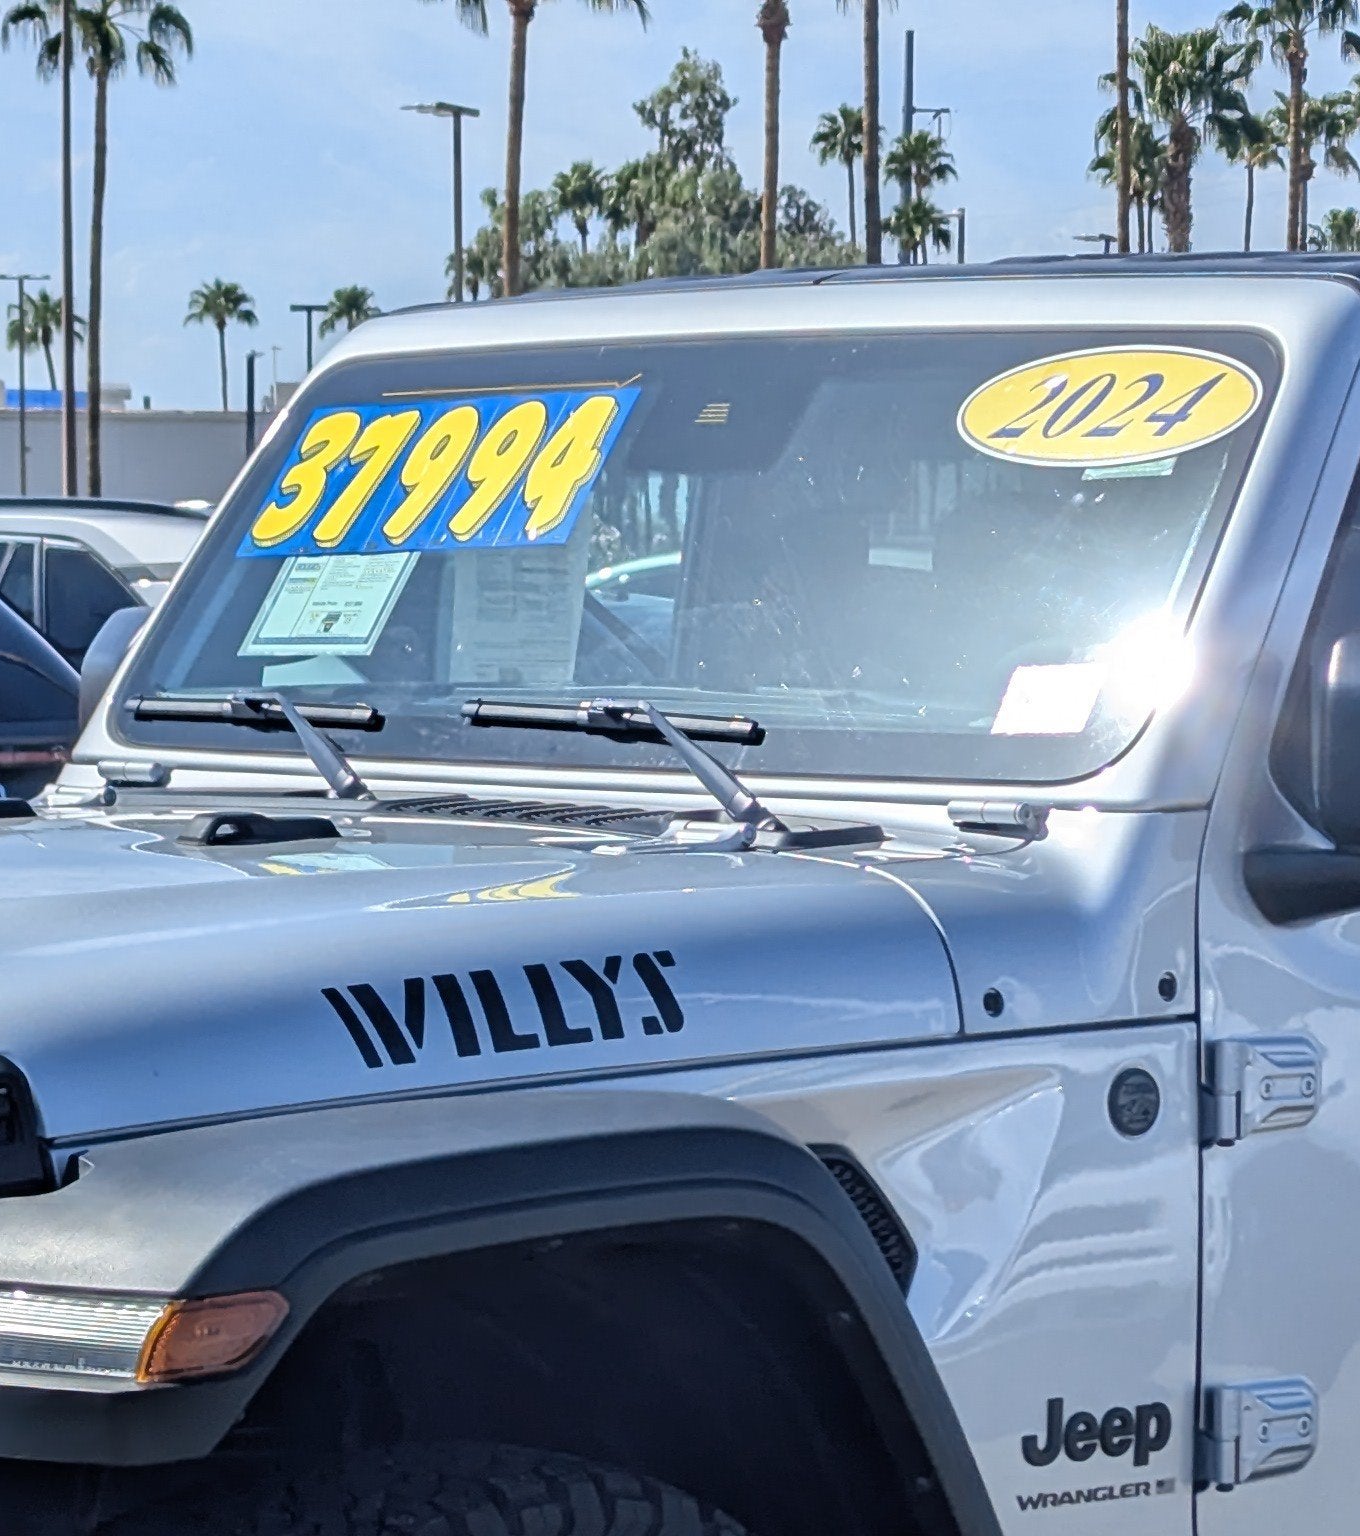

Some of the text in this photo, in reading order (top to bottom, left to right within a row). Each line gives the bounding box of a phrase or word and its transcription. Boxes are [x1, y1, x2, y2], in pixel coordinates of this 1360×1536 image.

[986, 371, 1228, 439] 2024
[251, 395, 619, 549] 37994
[320, 950, 684, 1068] WILLYS
[1021, 1397, 1172, 1467] Jeep
[1015, 1481, 1151, 1511] WRANGLER
